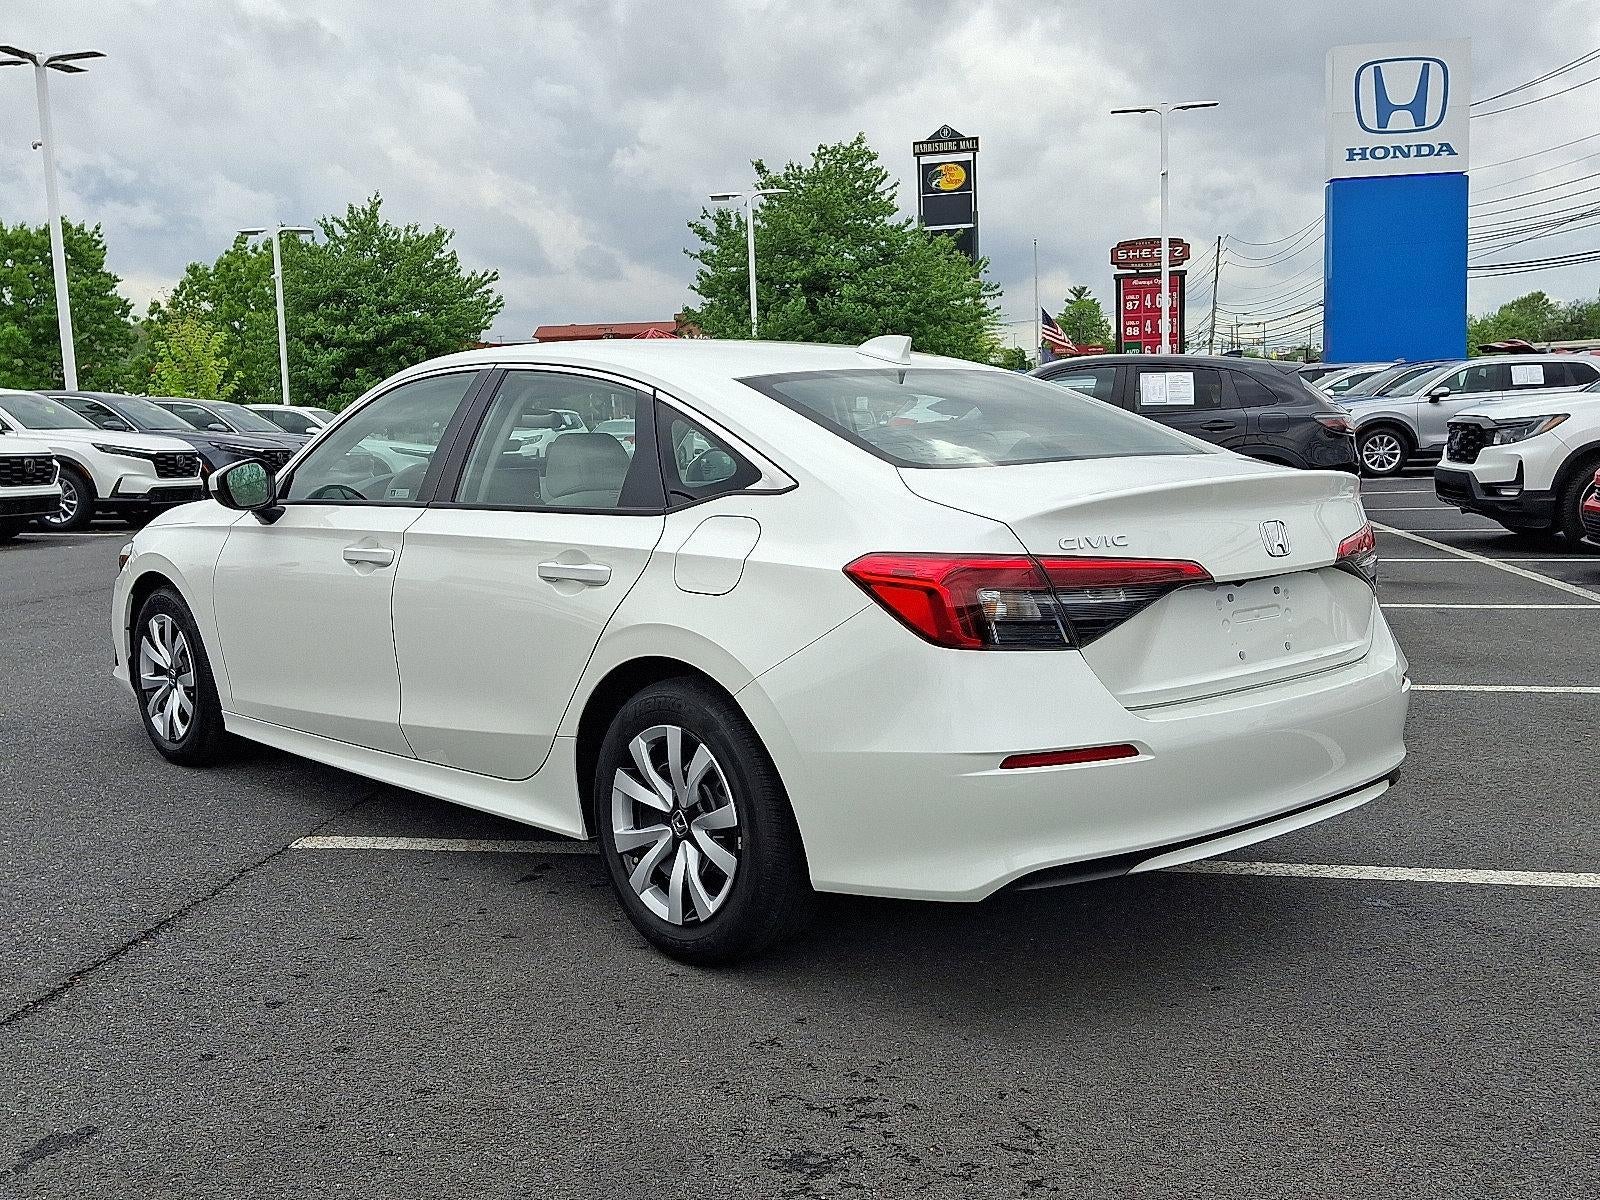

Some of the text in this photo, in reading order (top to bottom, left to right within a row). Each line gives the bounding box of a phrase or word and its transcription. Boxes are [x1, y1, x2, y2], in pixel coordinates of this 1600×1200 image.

[914, 139, 977, 153] HARRISBURG MALL
[1345, 142, 1459, 162] HONDA
[1117, 246, 1184, 260] SHEEZ
[1125, 300, 1140, 310] 87
[1125, 326, 1140, 336] 88
[1058, 534, 1129, 551] CIVIC
